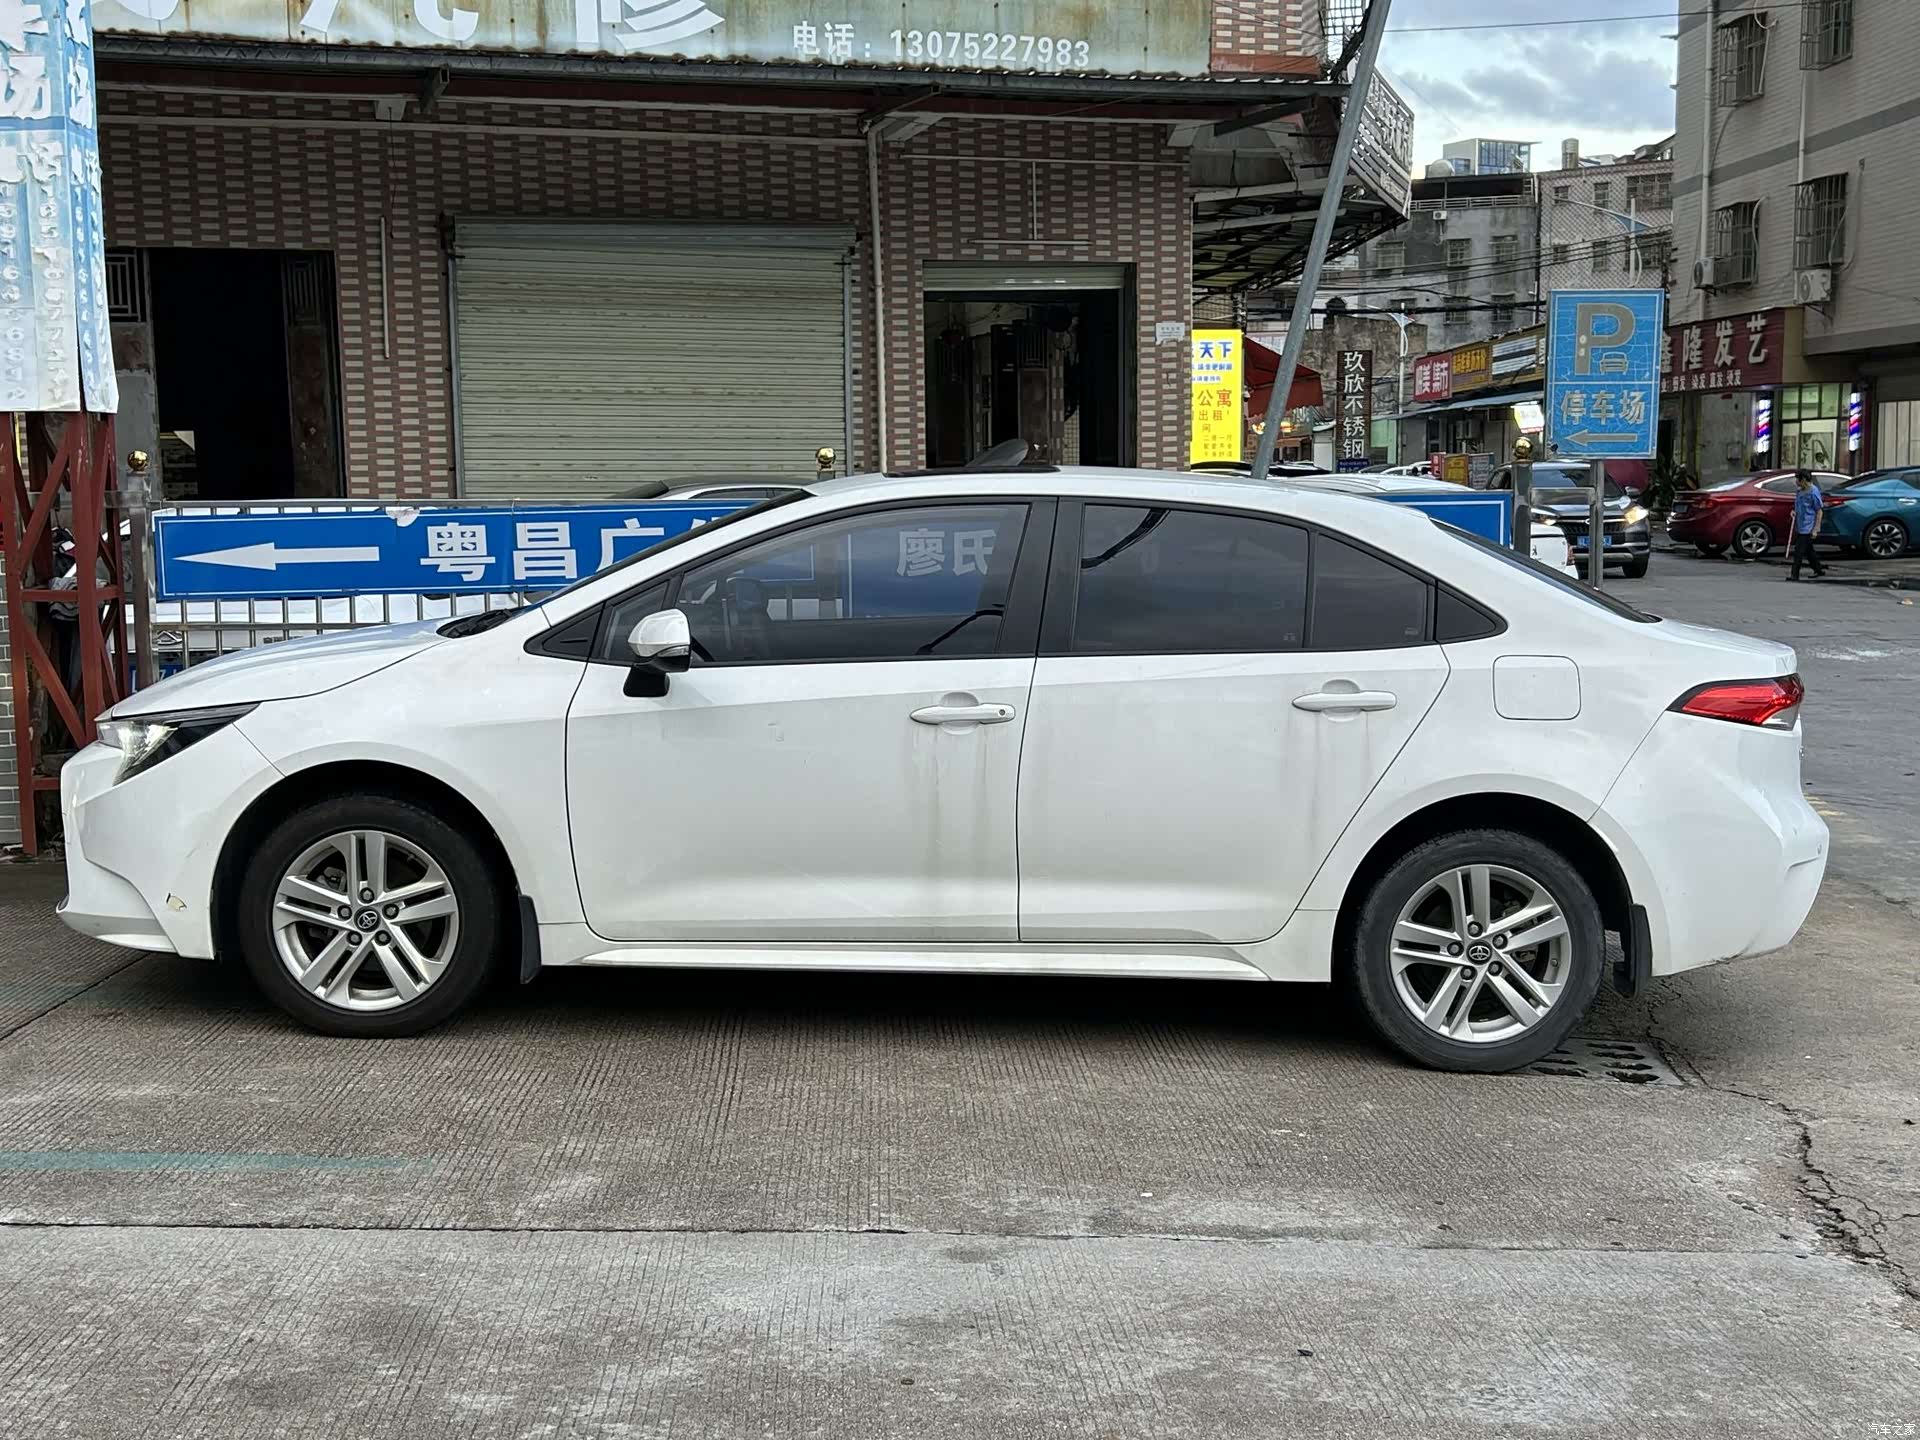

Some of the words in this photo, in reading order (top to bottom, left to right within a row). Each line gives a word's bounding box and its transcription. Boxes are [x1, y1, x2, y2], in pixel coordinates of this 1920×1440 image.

[890, 29, 1090, 67] 13075227983
[1192, 341, 1232, 358] 天下
[1192, 389, 1232, 407] 公寓
[1343, 351, 1365, 459] 玖欣不锈钢
[1560, 390, 1649, 425] 停车场
[420, 518, 720, 582] 粤昌广
[897, 528, 996, 576] 廖氏
